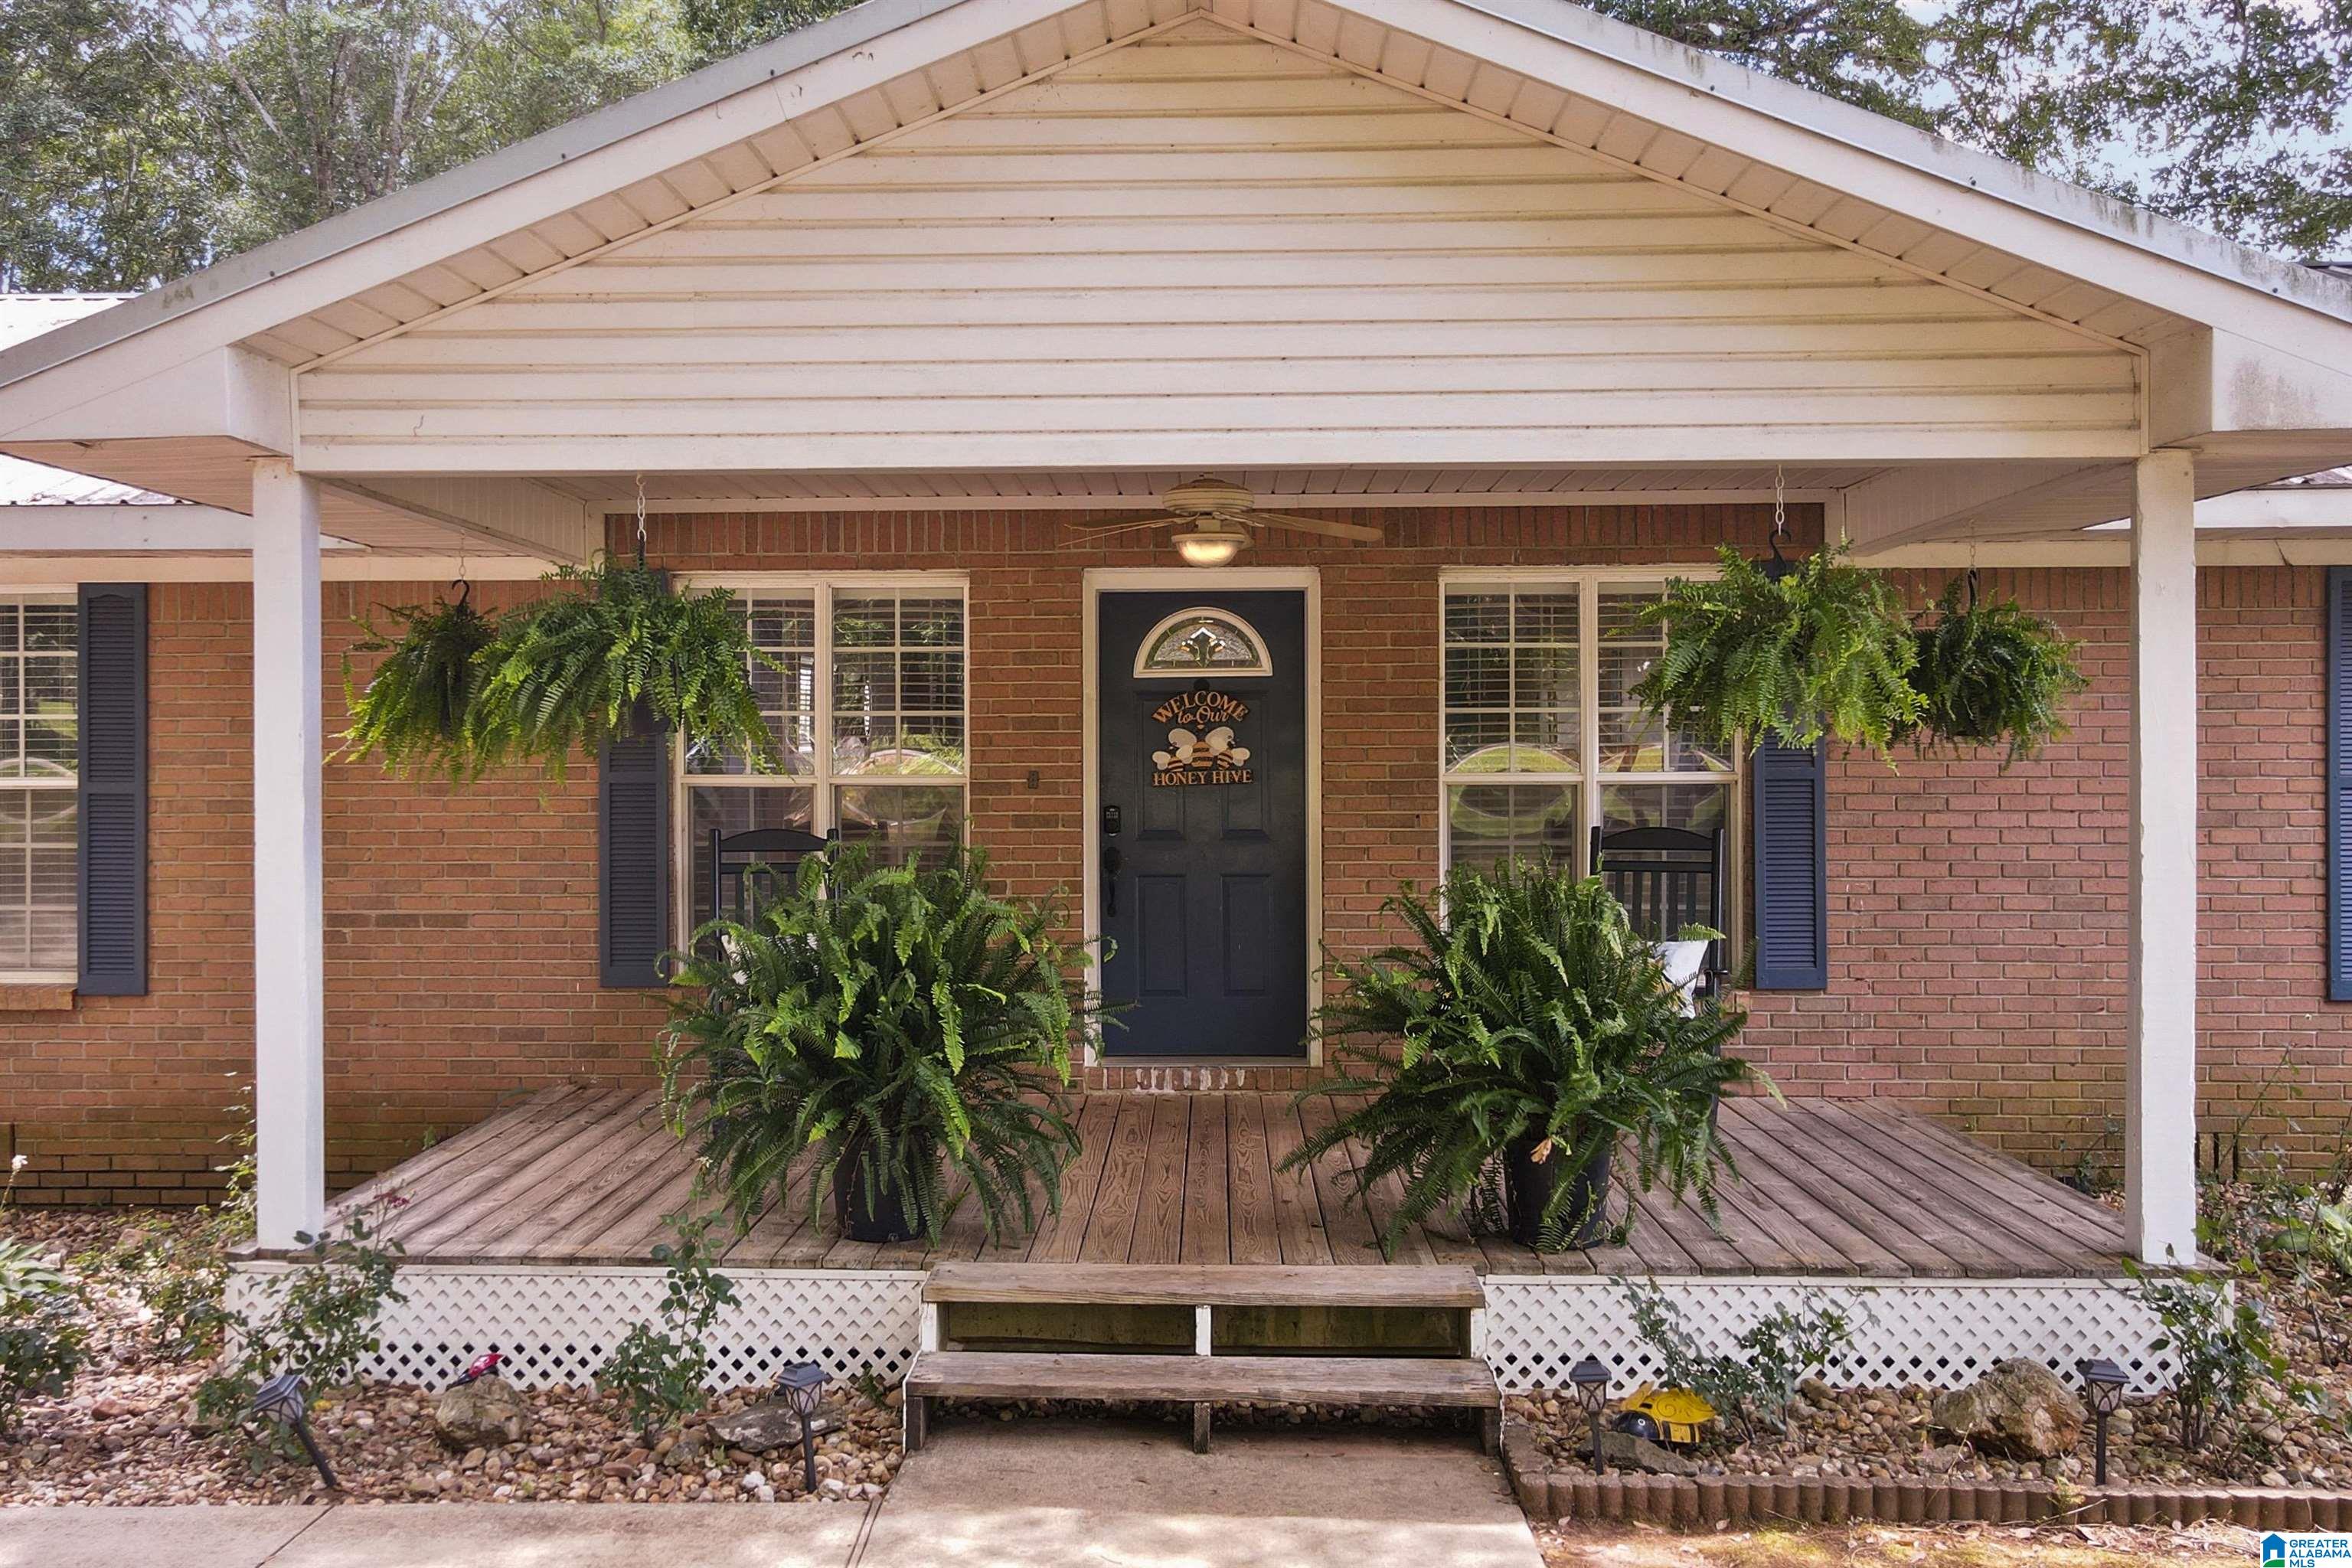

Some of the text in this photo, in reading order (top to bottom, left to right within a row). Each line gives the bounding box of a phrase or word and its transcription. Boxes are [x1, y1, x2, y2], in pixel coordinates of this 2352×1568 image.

[1152, 690, 1250, 723] WELCOME
[1153, 769, 1253, 786] HONEY HIVE
